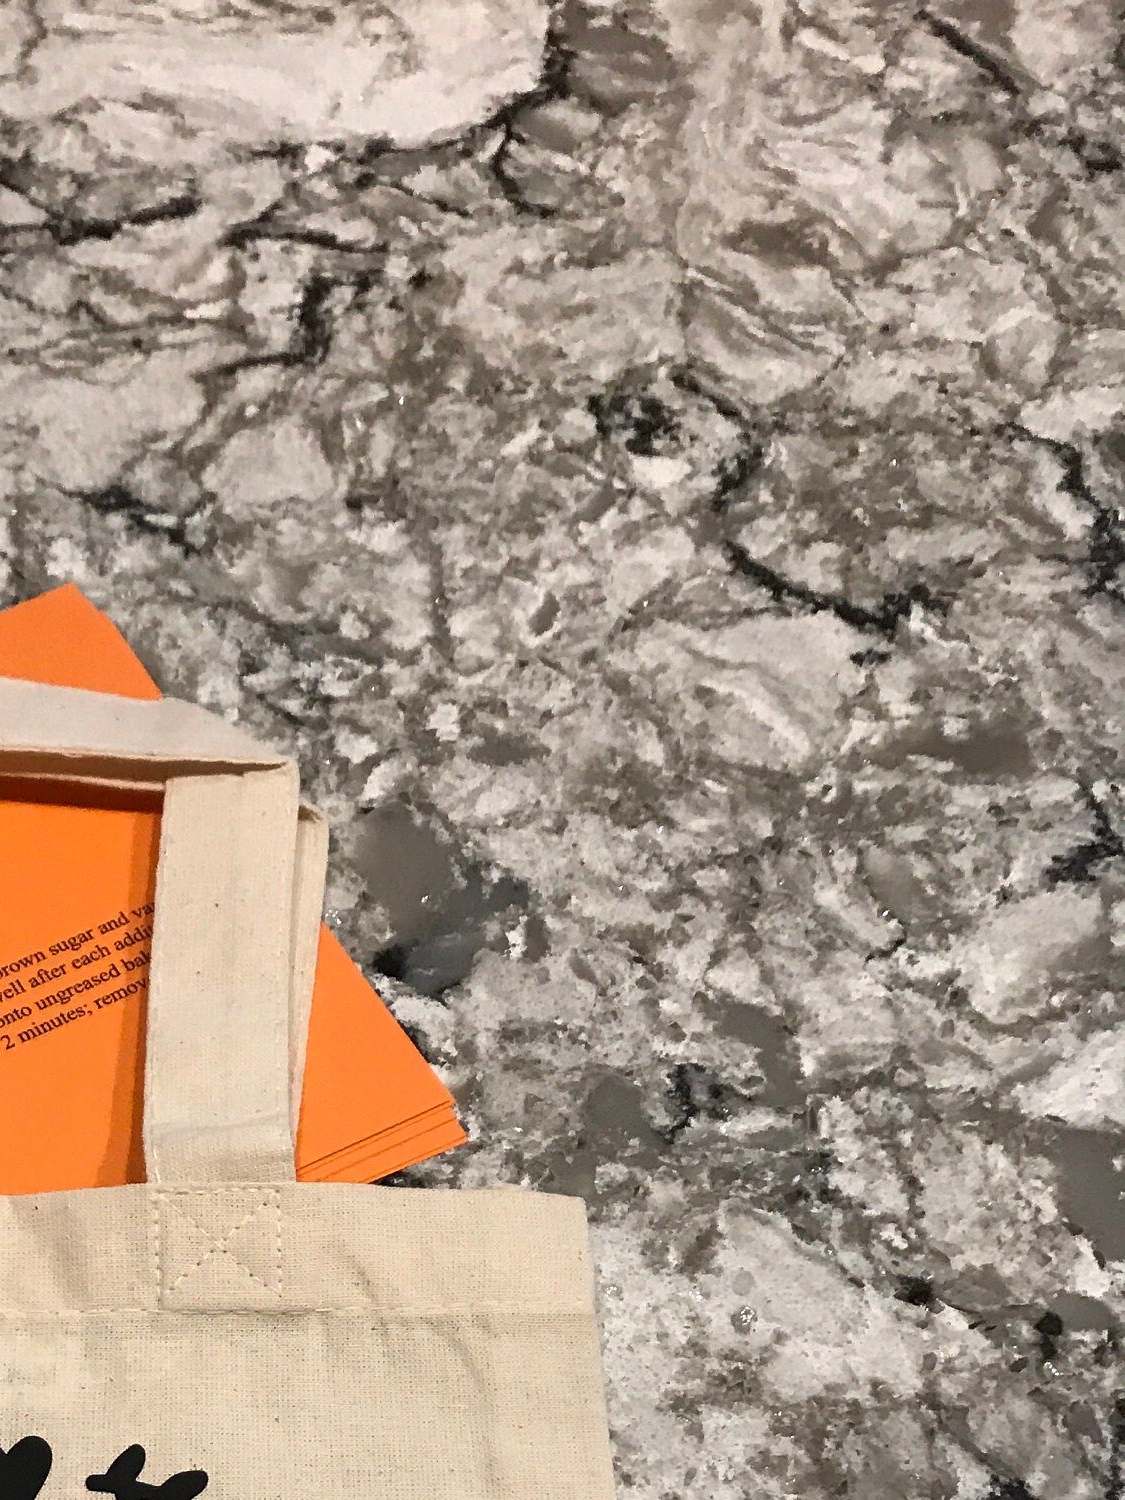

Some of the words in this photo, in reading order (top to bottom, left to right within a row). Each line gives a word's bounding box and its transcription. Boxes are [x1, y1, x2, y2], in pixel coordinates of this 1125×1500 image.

[48, 928, 95, 956] sugar
[97, 911, 131, 935] and
[28, 963, 67, 989] after
[71, 944, 112, 970] each
[34, 963, 122, 1011] ungreased
[0, 1034, 16, 1050] 2
[17, 1004, 93, 1043] minutes;
[93, 969, 151, 1010] remov
